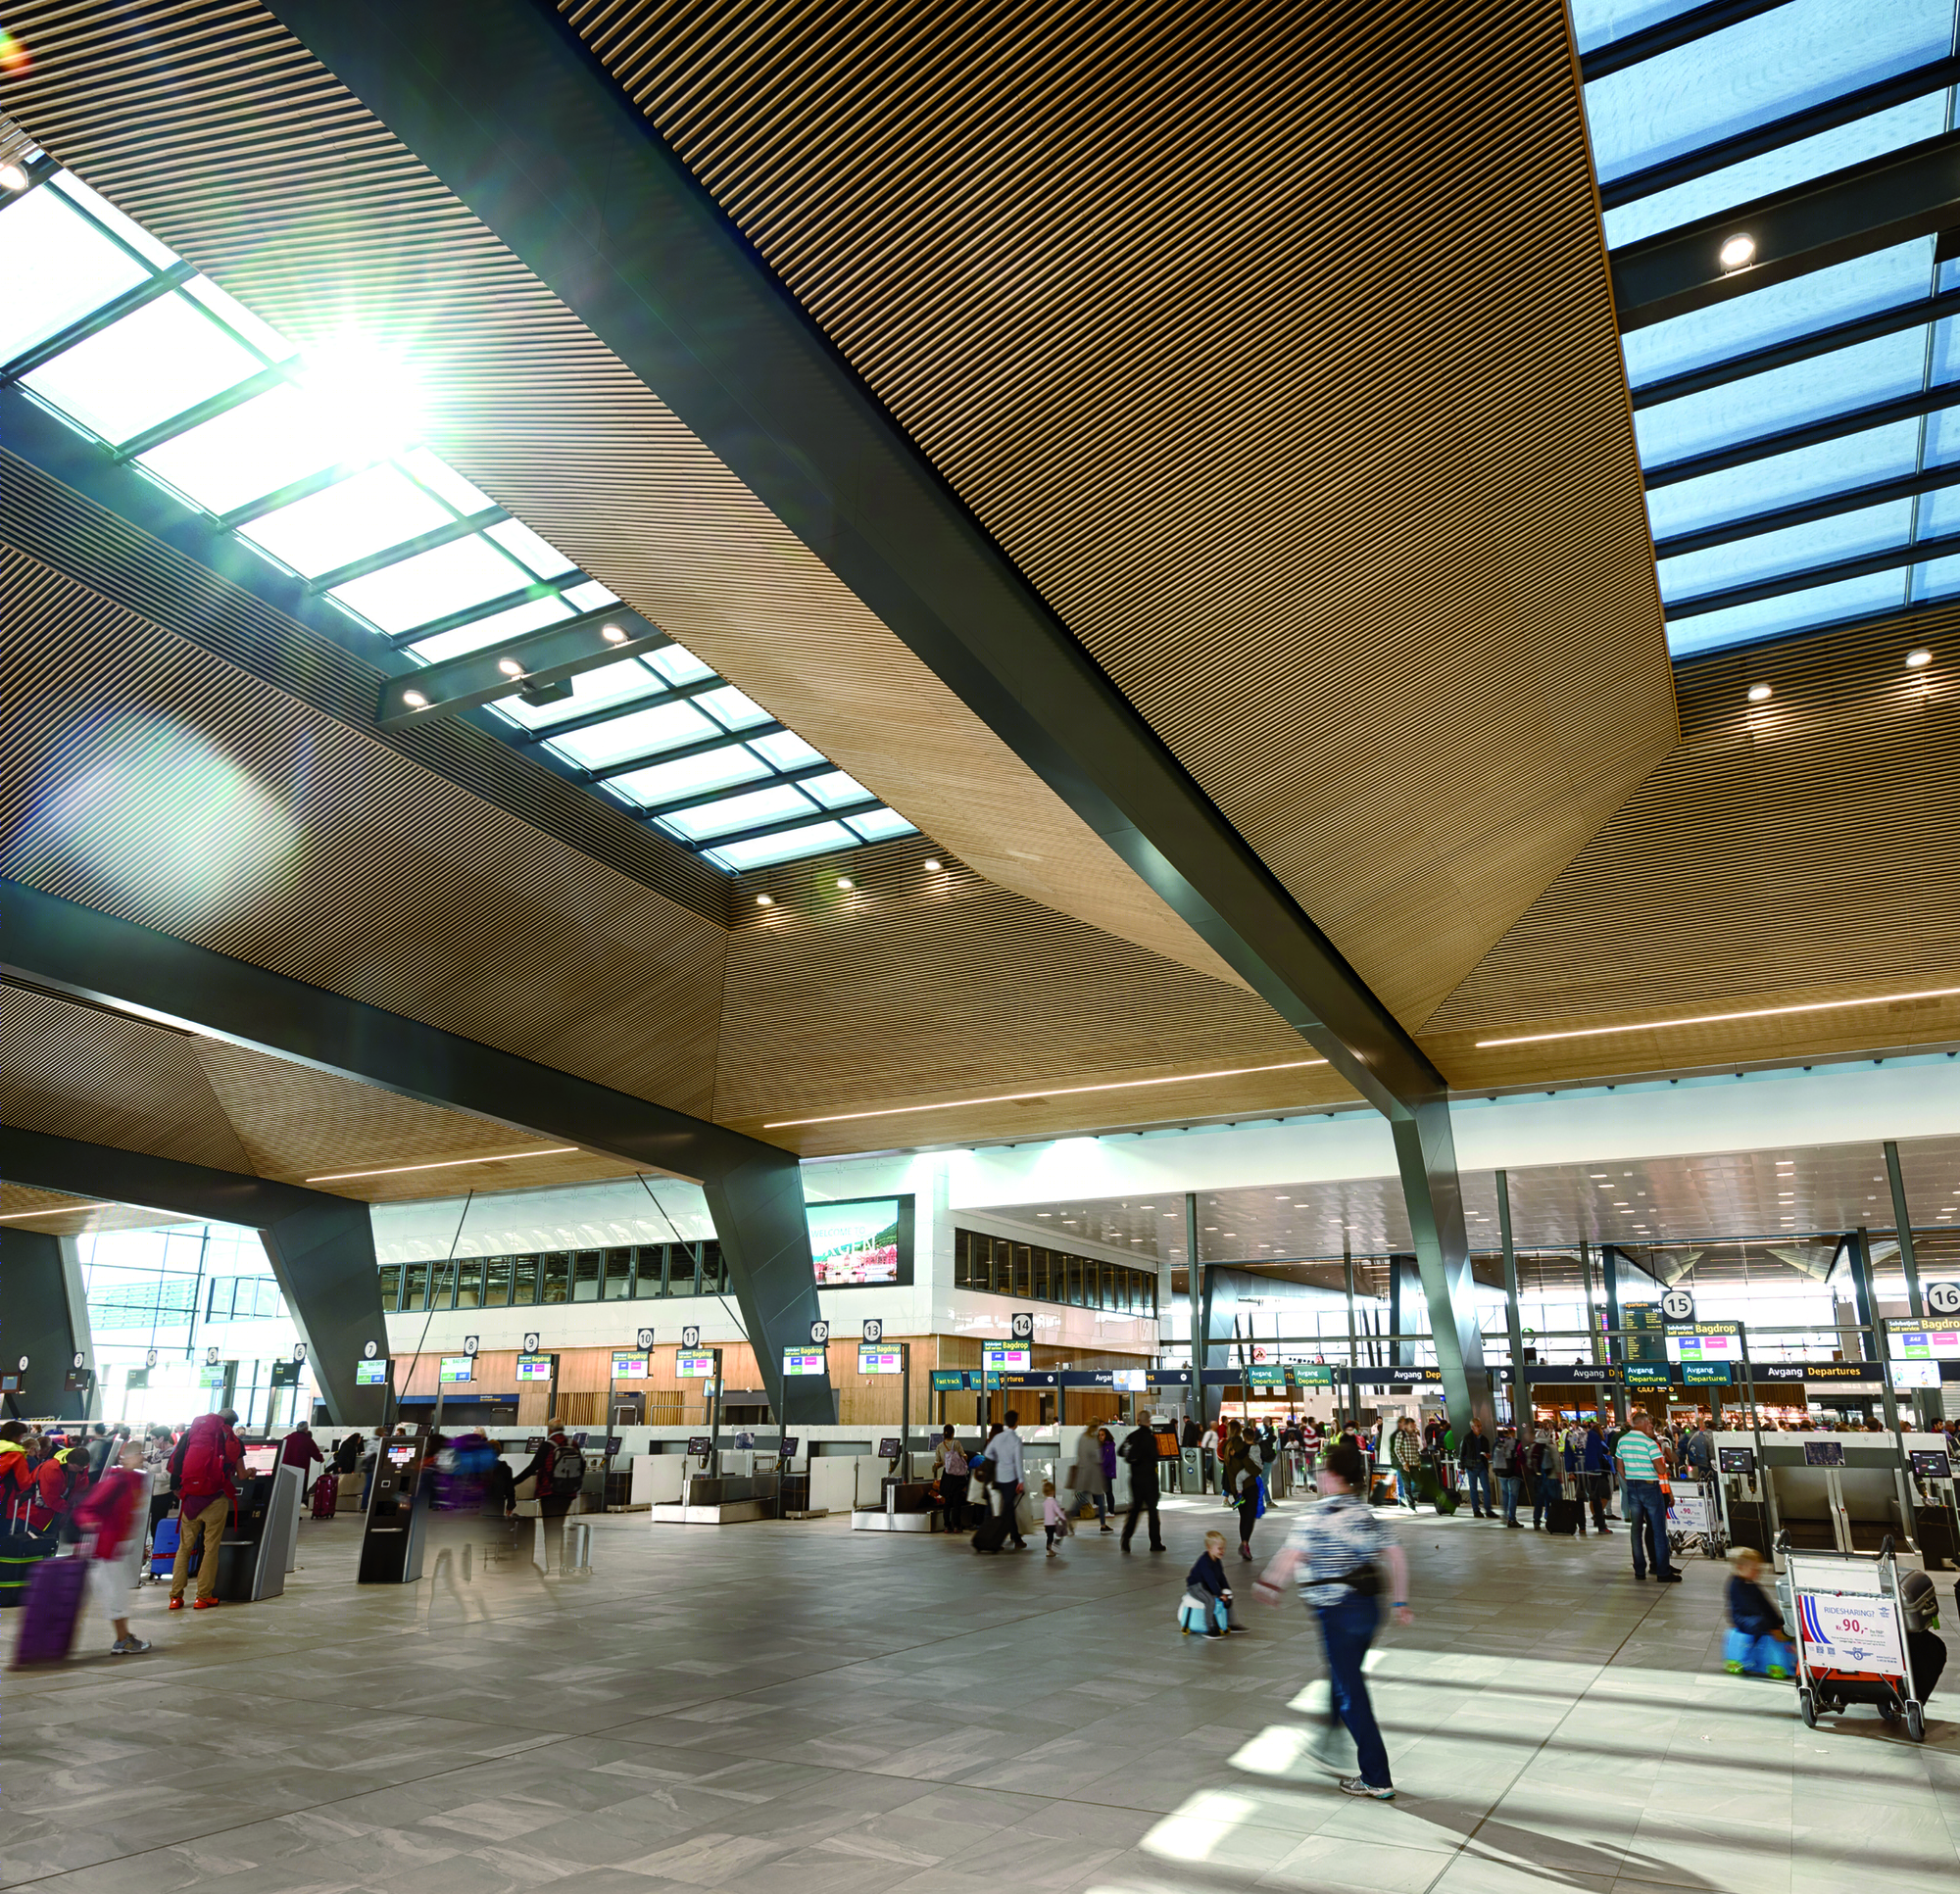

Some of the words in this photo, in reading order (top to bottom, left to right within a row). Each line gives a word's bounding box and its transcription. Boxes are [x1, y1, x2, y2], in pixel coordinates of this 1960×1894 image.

[810, 1227, 852, 1238] WELCOME
[854, 1226, 865, 1235] TO
[1934, 1289, 1959, 1305] 16
[1667, 1298, 1689, 1312] 15
[1015, 1319, 1030, 1332] 14
[1695, 1324, 1736, 1335] Bagdrop
[1921, 1319, 1960, 1331] Bagdro
[813, 1327, 826, 1337] 12
[866, 1325, 879, 1336] 13
[640, 1334, 652, 1344] 10
[685, 1332, 696, 1342] 11
[468, 1341, 474, 1350] 8
[528, 1338, 534, 1348] 9
[1003, 1341, 1029, 1350] Bagdrop
[297, 1347, 303, 1357] 6
[368, 1345, 373, 1354] 7
[692, 1349, 712, 1358] Bagdrop
[801, 1346, 823, 1355] Bagdrop
[876, 1345, 900, 1354] Bagdrop
[210, 1351, 215, 1360] 5
[627, 1352, 647, 1361] Bagdrop
[1394, 1371, 1422, 1380] Avgang
[1573, 1369, 1604, 1379] Avgang
[1768, 1367, 1803, 1378] Avgang
[1807, 1367, 1861, 1378] Departures
[1824, 1606, 1875, 1618] RIDESHARING?
